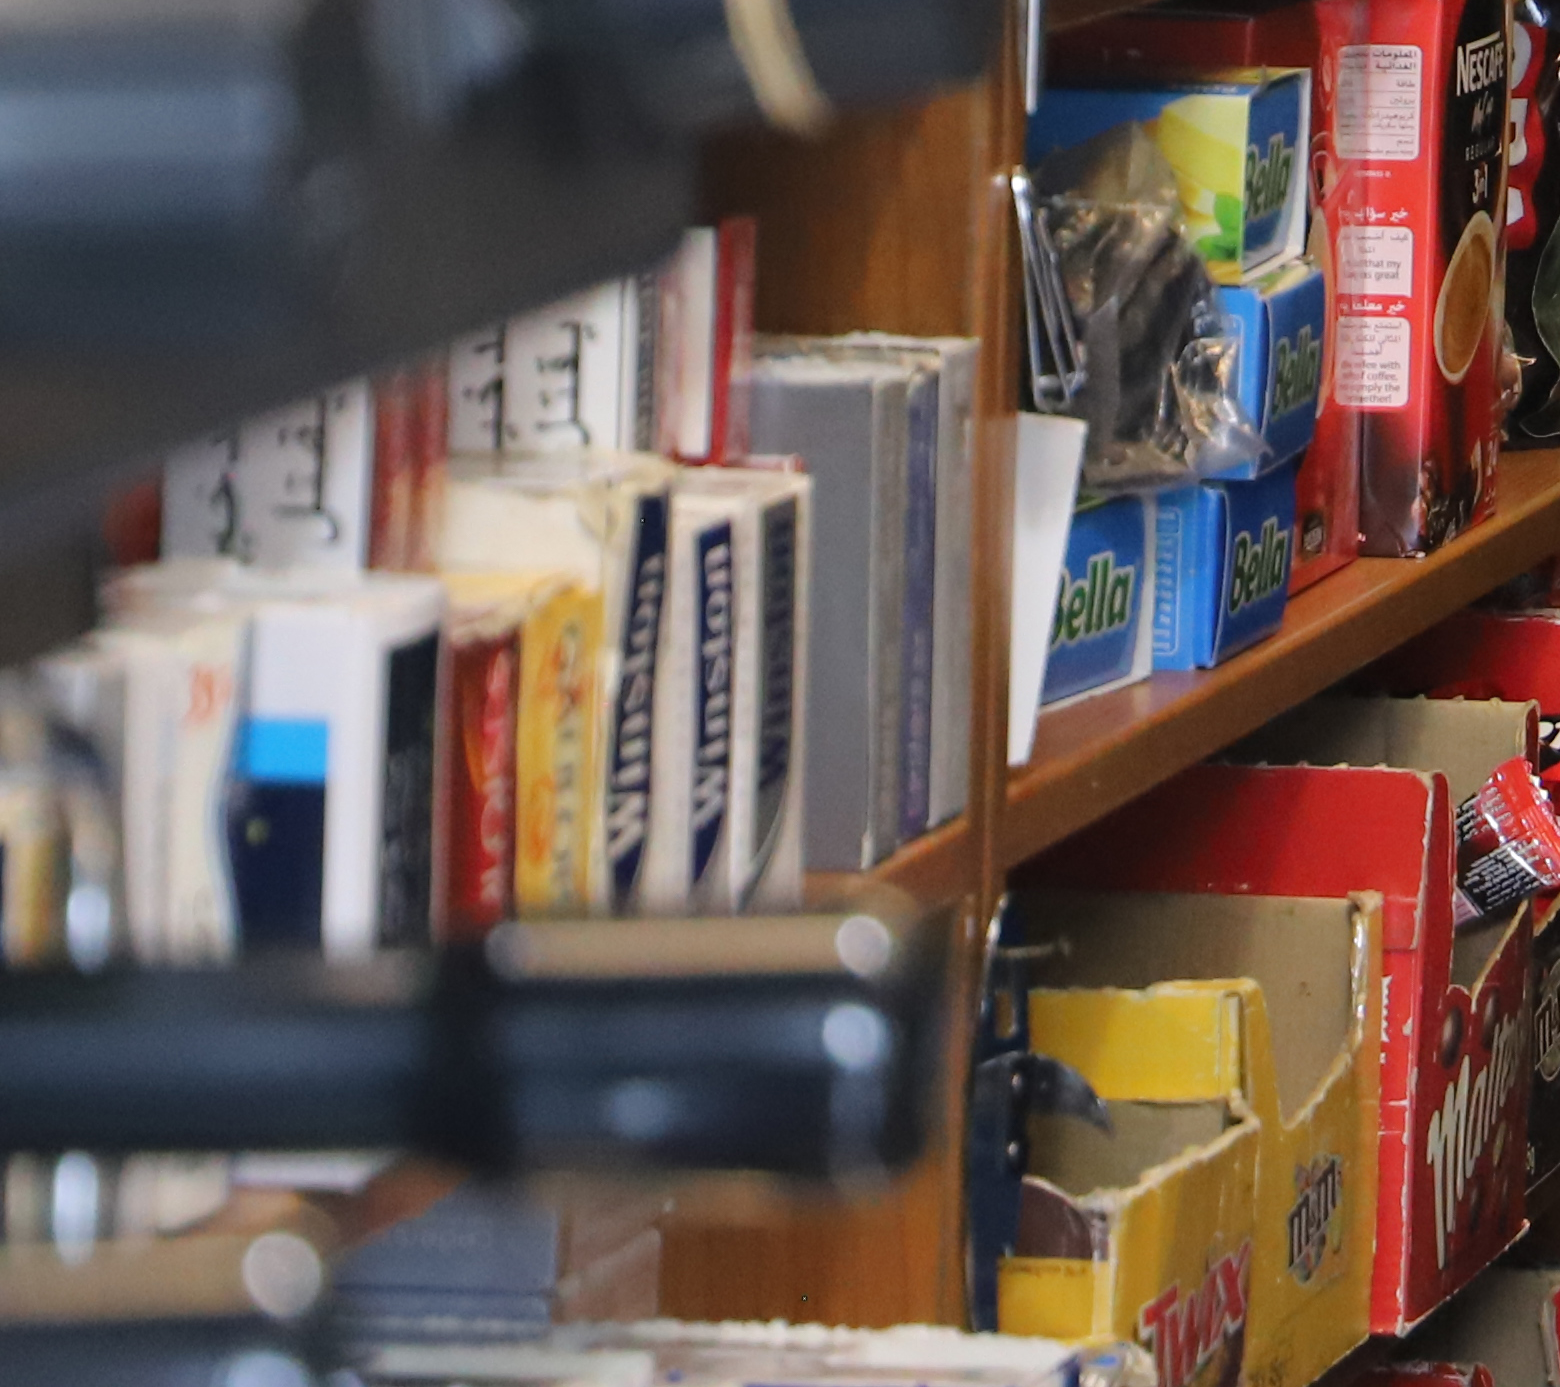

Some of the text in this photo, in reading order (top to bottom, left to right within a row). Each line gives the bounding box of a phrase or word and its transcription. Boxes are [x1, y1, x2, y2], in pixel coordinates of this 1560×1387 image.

[1244, 131, 1297, 224] Bella
[1272, 322, 1321, 421] Bella
[1227, 516, 1292, 615] Bella
